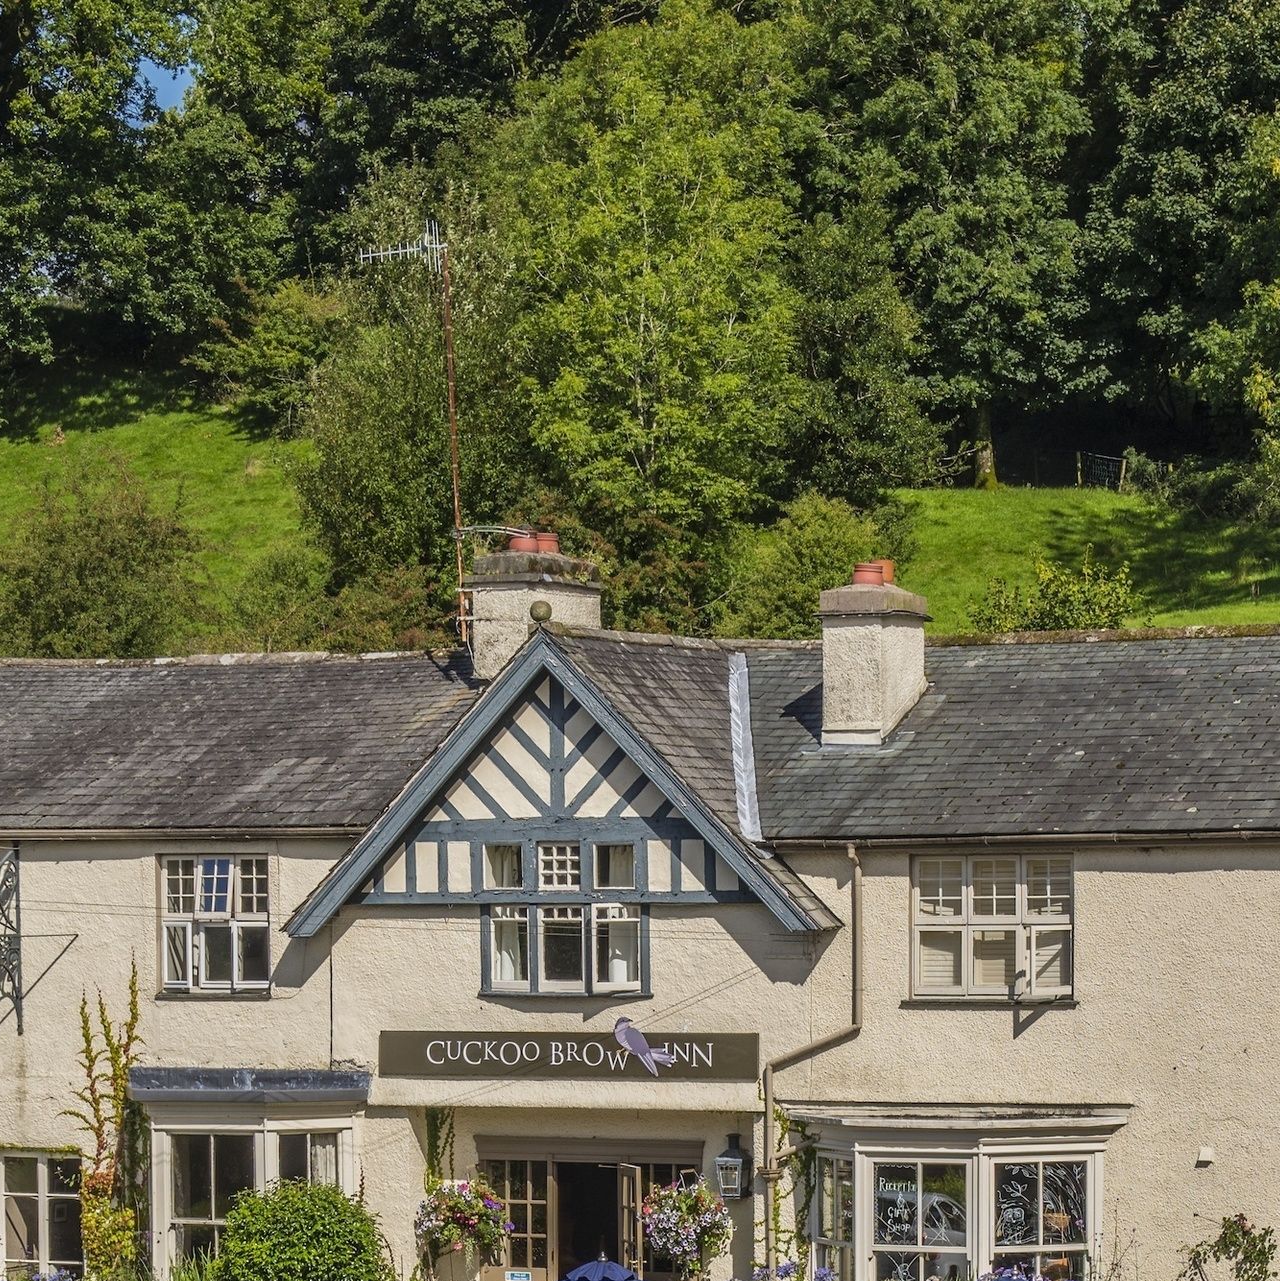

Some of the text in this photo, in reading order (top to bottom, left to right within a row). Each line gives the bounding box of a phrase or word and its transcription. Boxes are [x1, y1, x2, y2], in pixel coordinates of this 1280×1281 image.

[426, 1040, 714, 1072] CUCKOO BROW INN
[887, 1218, 911, 1233] SHOP
